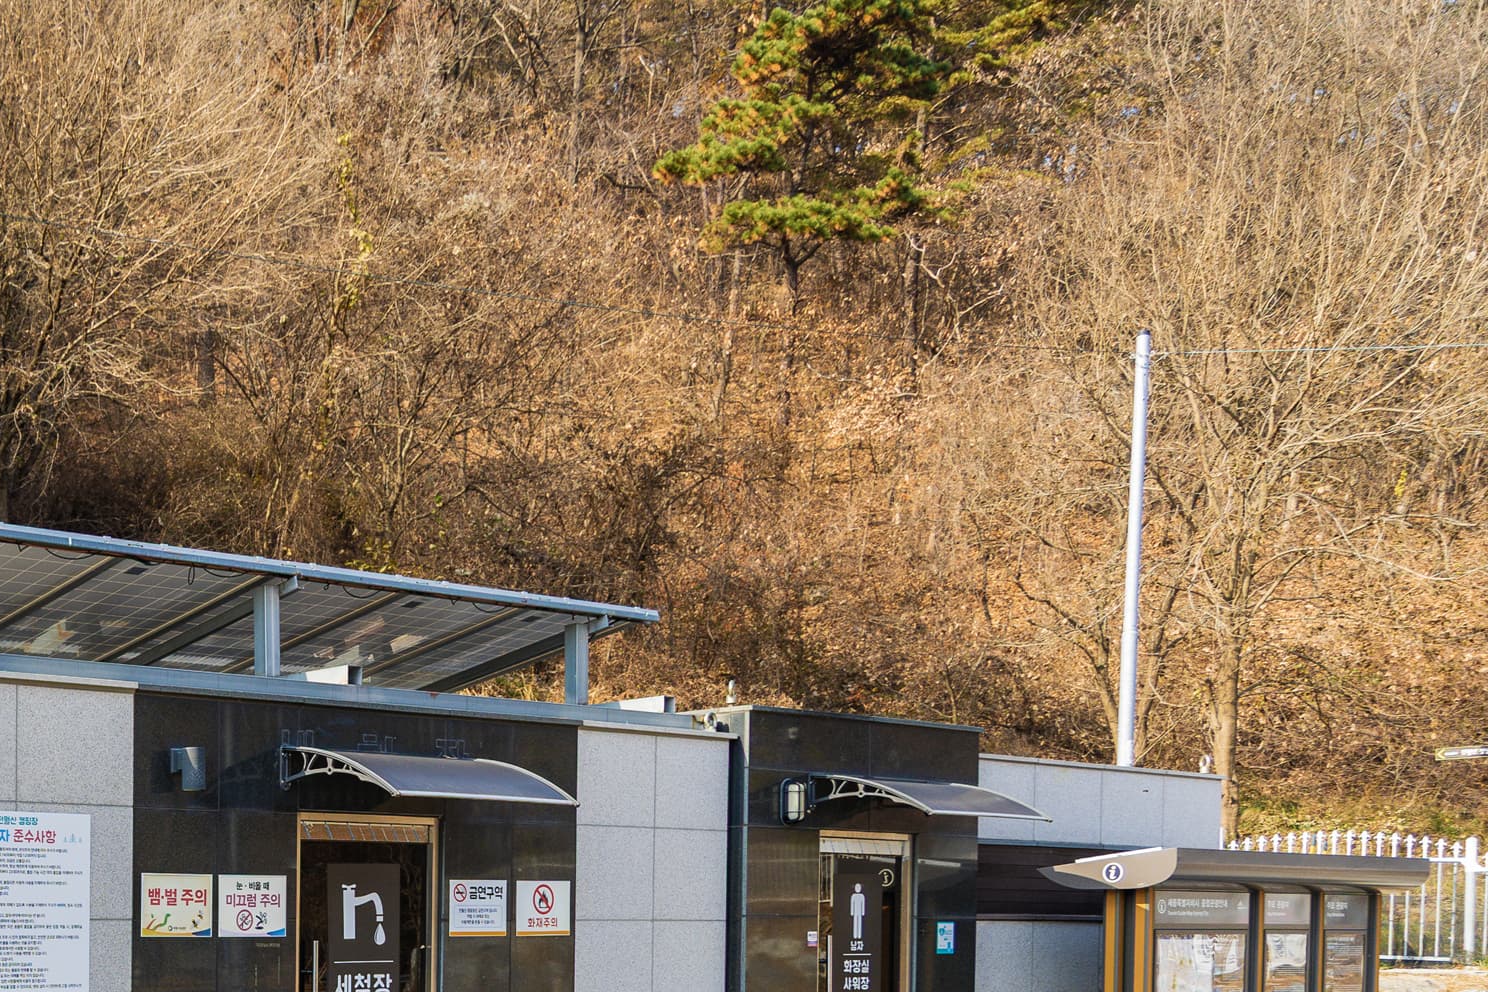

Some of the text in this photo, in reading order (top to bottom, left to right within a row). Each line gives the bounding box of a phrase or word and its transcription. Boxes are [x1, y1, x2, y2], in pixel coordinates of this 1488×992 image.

[13, 829, 56, 844] 준수사항
[180, 889, 207, 907] 주의
[469, 886, 504, 900] 금연구역
[226, 893, 281, 908] 미끄럼 주의
[527, 918, 558, 928] 화재주의
[850, 941, 864, 951] 남자
[843, 960, 870, 974] 화장실
